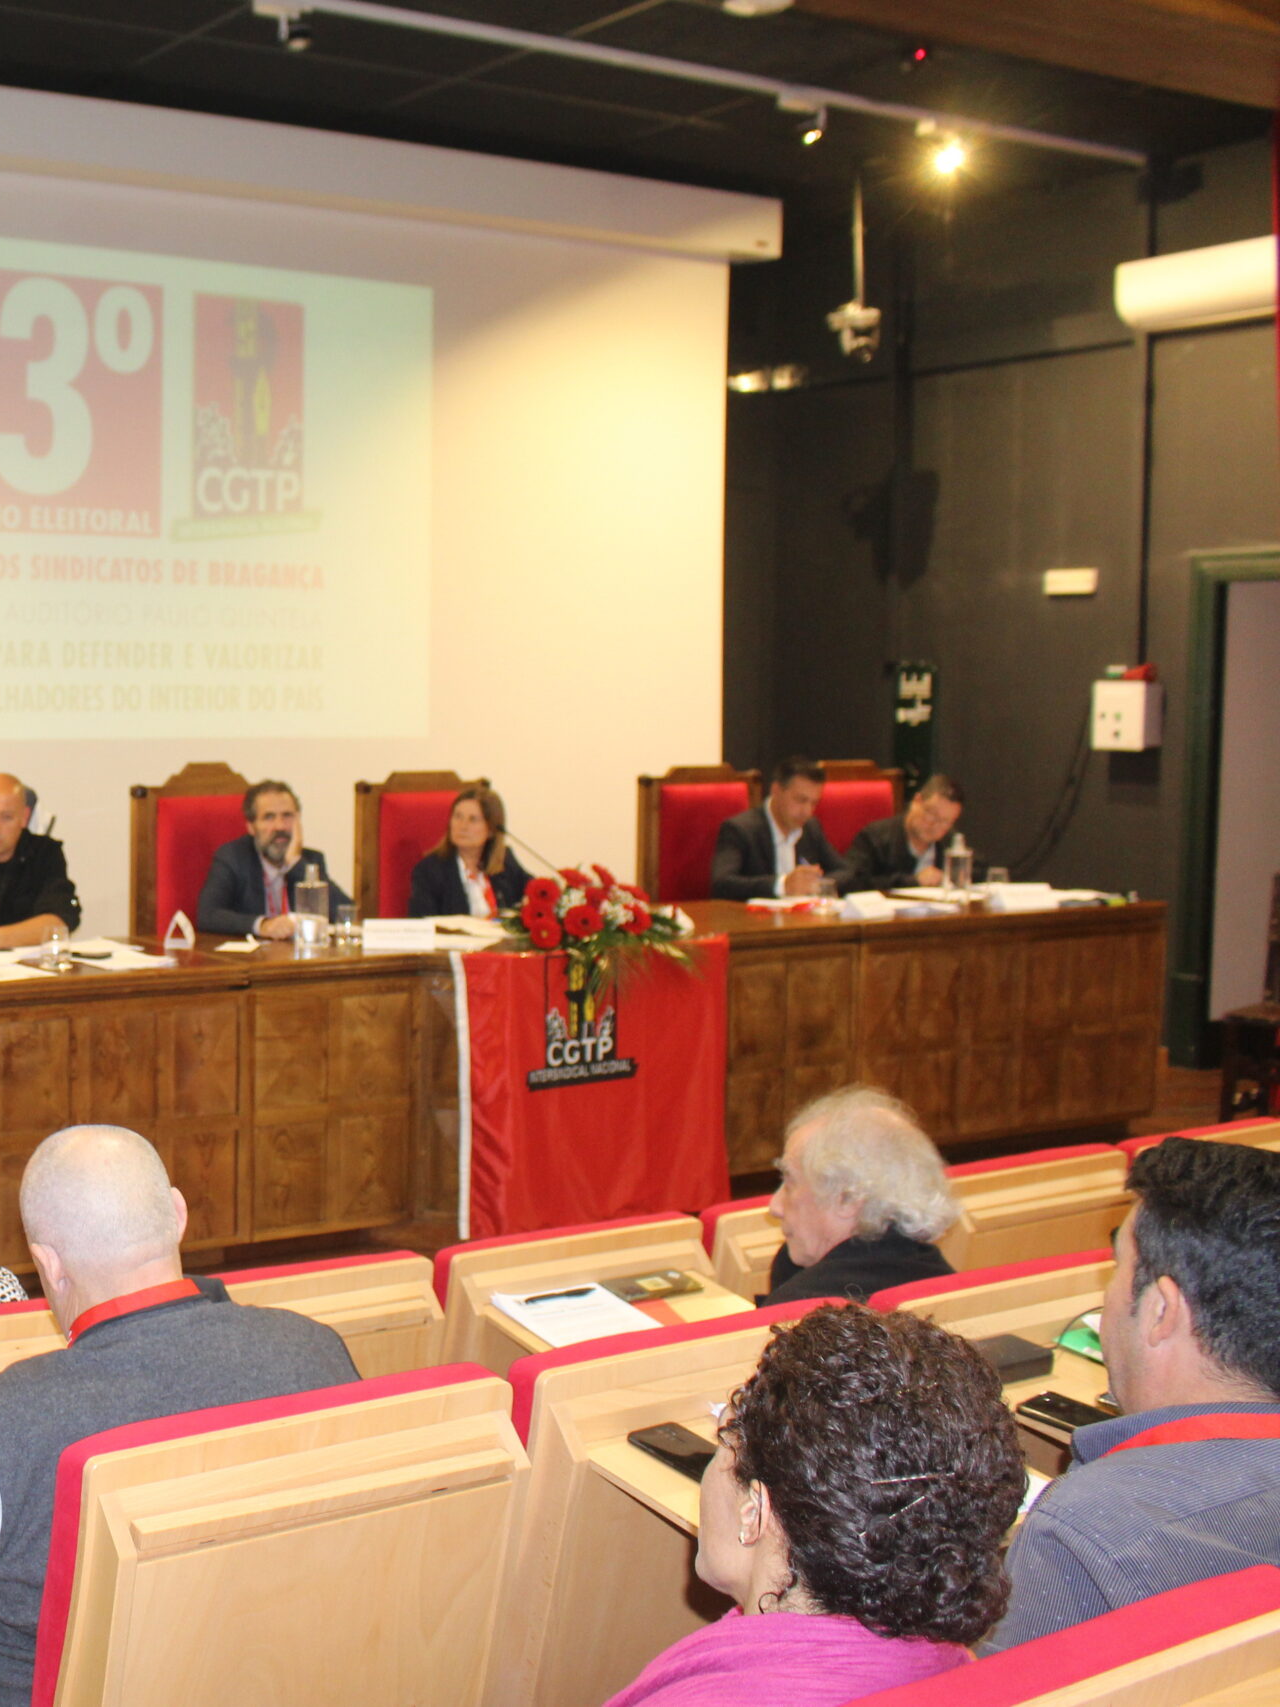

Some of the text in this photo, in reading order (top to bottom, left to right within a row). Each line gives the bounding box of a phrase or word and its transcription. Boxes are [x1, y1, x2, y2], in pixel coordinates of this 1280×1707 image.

[195, 466, 302, 513] CGTP
[29, 504, 153, 534] ELEITORAL
[29, 554, 164, 584] SINDICATOS
[172, 559, 199, 585] DE
[208, 560, 325, 591] BRAGANÇA
[62, 640, 174, 670] DEFENDER
[183, 641, 194, 670] E
[203, 642, 324, 671] VALORIZAR
[112, 684, 142, 712] DO
[149, 684, 242, 712] INTERIOR
[248, 684, 276, 712] DO
[546, 1036, 613, 1066] CGTP
